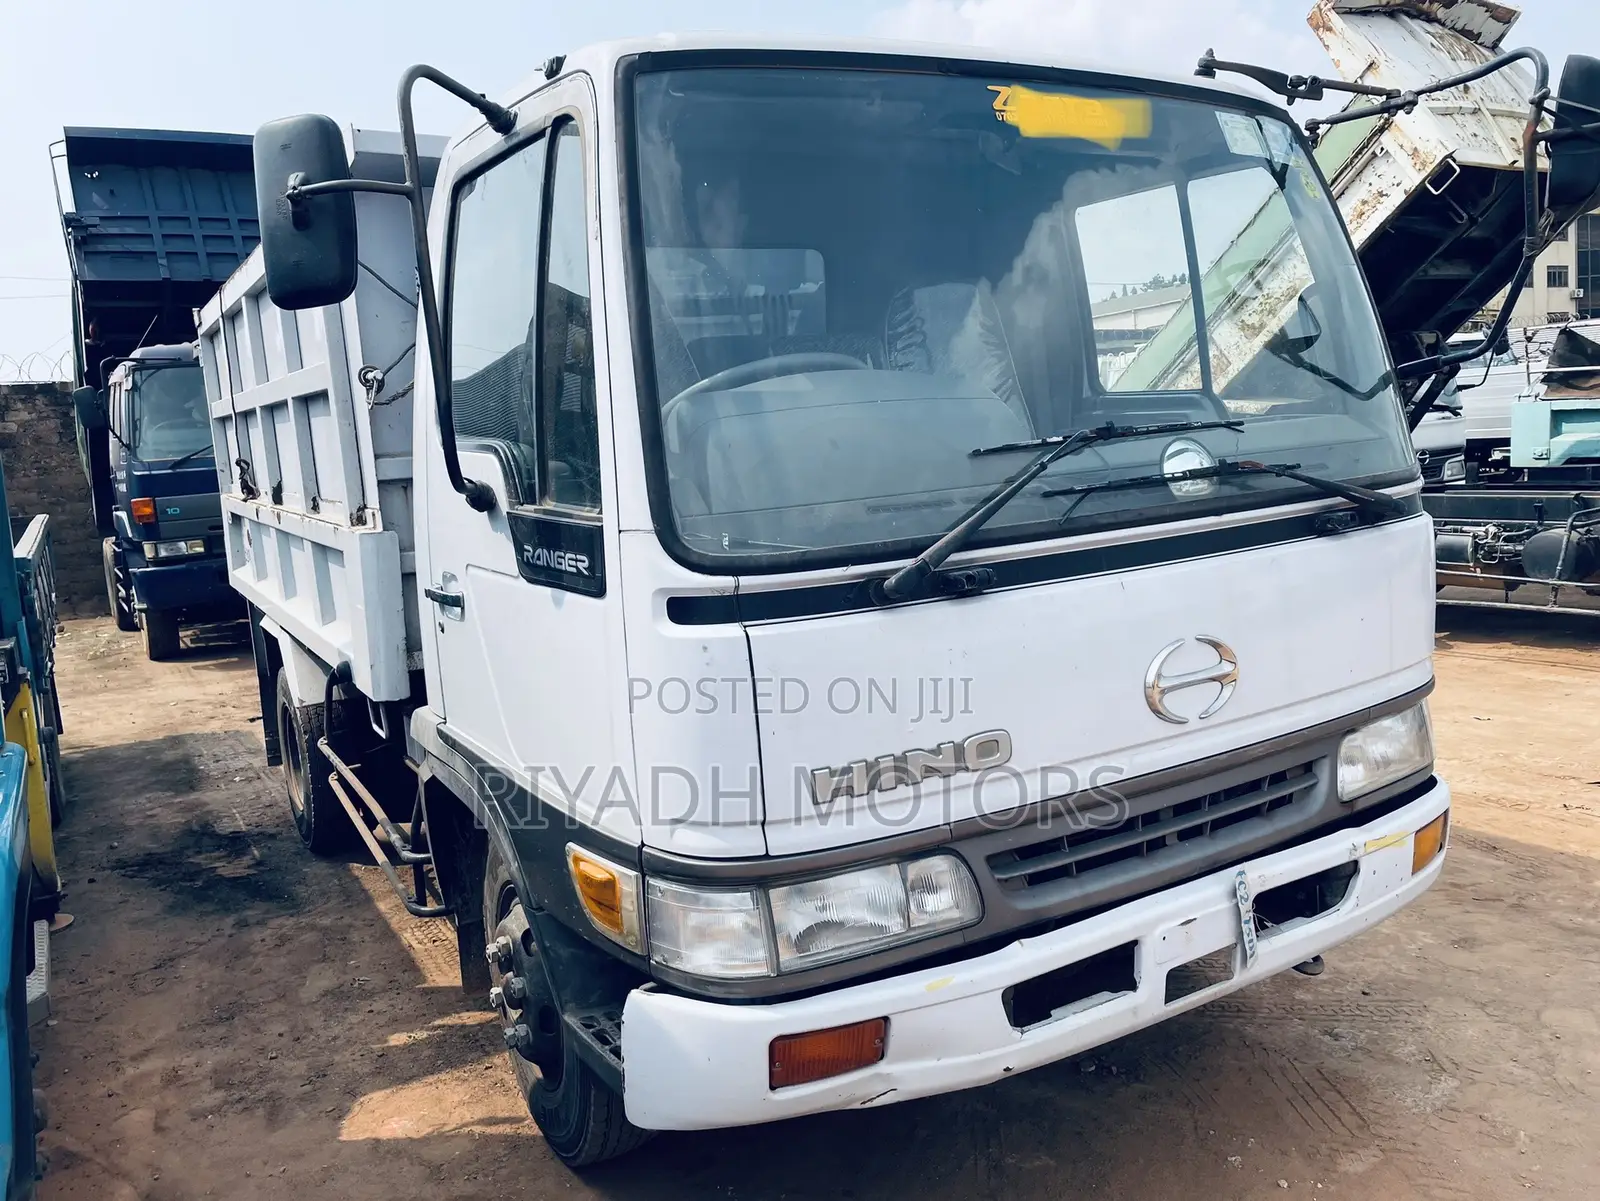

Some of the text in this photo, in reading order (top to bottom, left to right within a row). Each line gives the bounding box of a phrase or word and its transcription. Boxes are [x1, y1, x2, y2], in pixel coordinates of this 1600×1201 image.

[166, 507, 180, 515] 10
[523, 544, 590, 576] RANGER
[811, 729, 1013, 805] HINO
